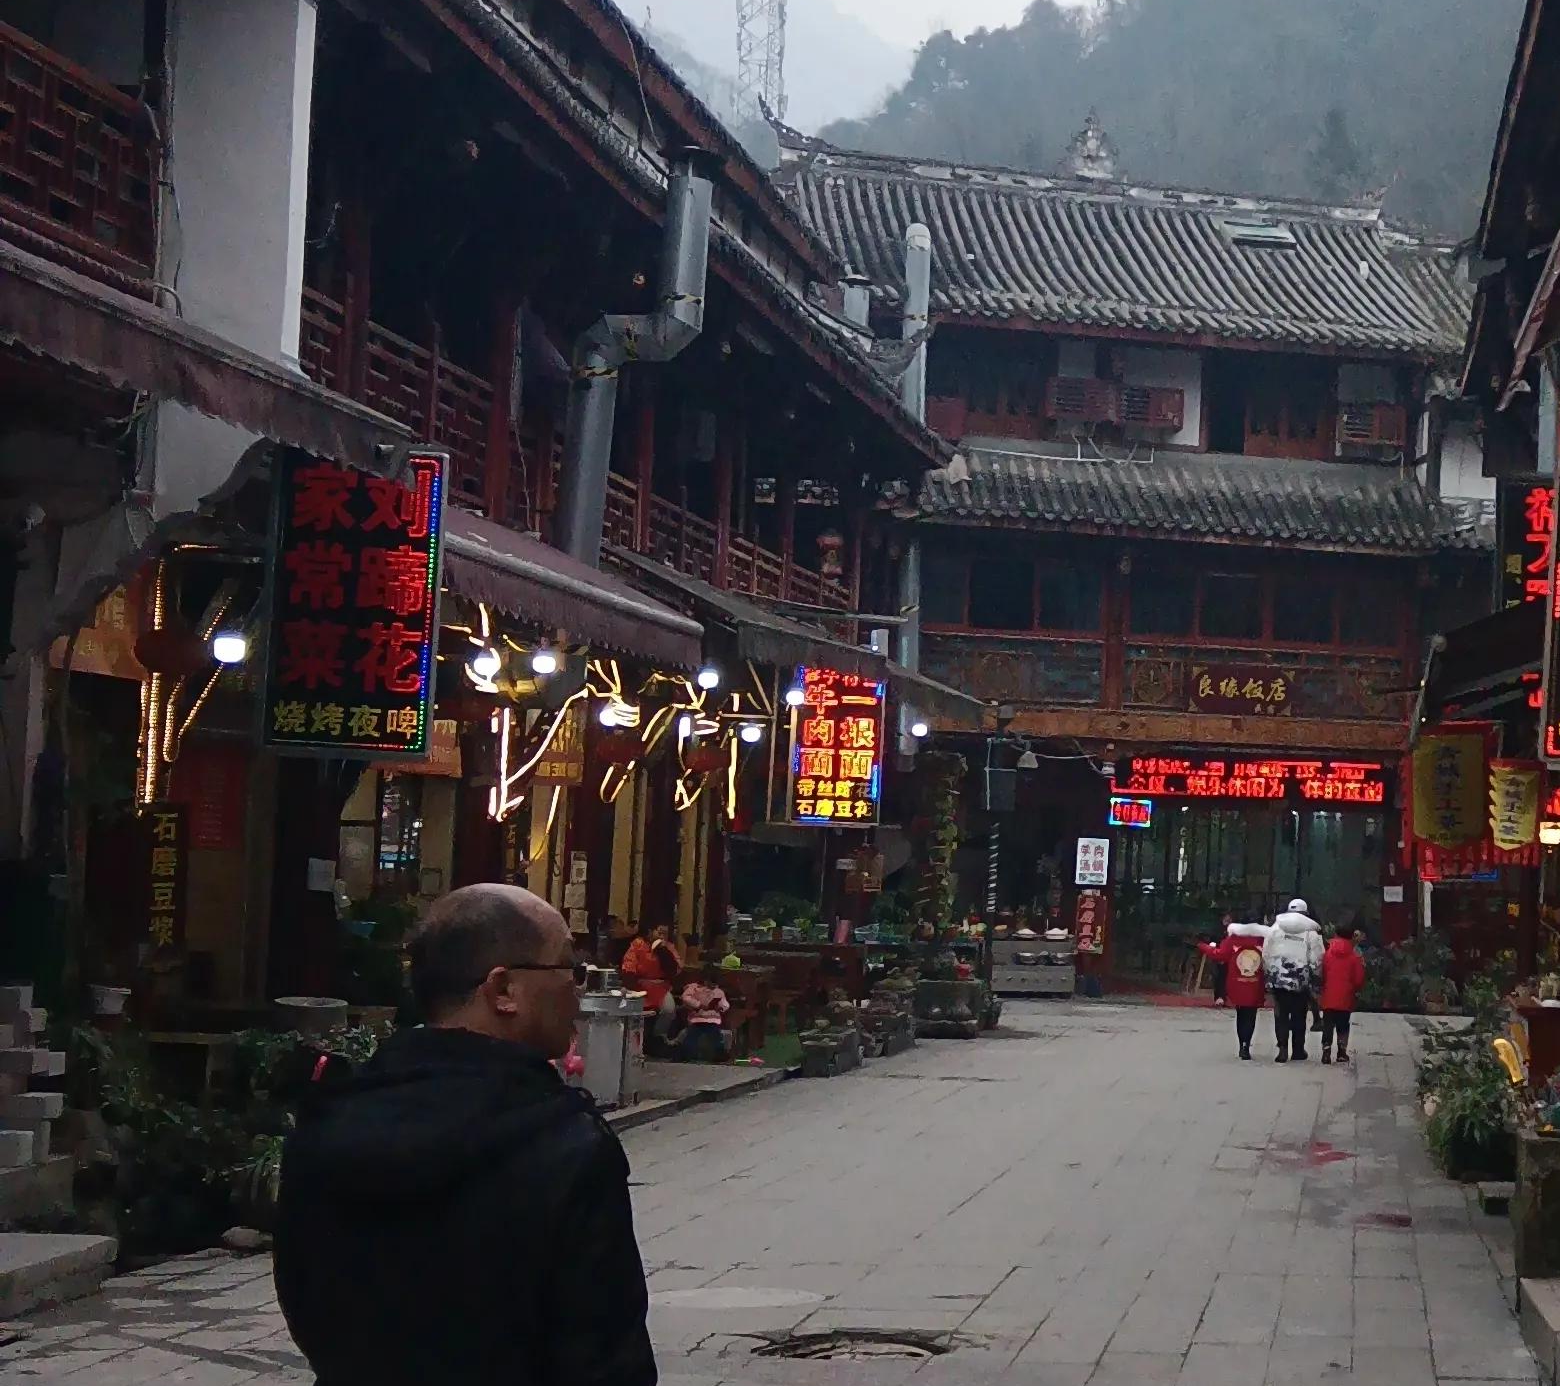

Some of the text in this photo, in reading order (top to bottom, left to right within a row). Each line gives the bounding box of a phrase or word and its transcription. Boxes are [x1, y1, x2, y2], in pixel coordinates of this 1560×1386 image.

[279, 463, 358, 690] 家常菜
[273, 699, 419, 741] 烧烤夜啤
[801, 683, 839, 779] 牛肉面
